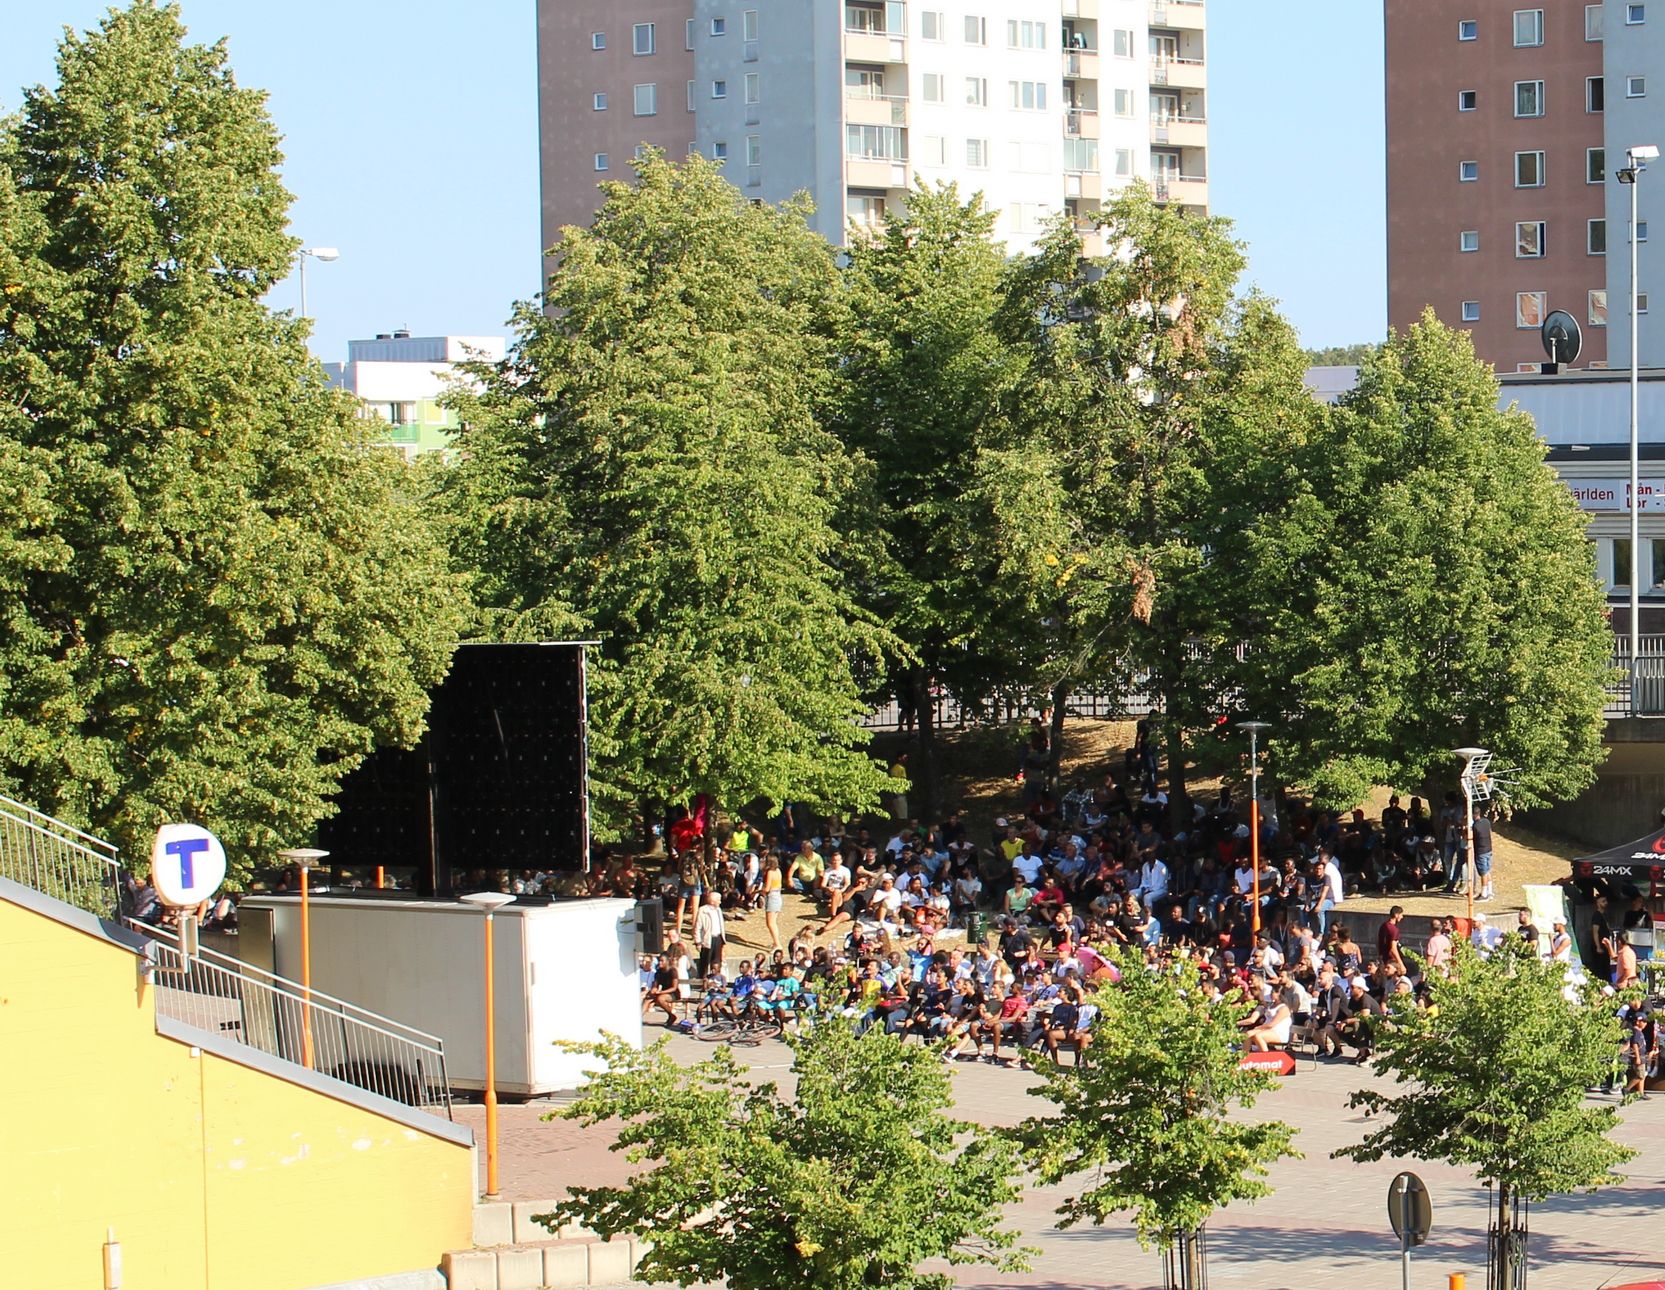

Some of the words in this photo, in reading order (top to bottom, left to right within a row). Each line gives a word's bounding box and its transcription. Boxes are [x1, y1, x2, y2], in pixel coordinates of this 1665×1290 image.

[1570, 487, 1615, 500] ärlden
[165, 838, 210, 889] T
[1593, 865, 1632, 877] 24MX
